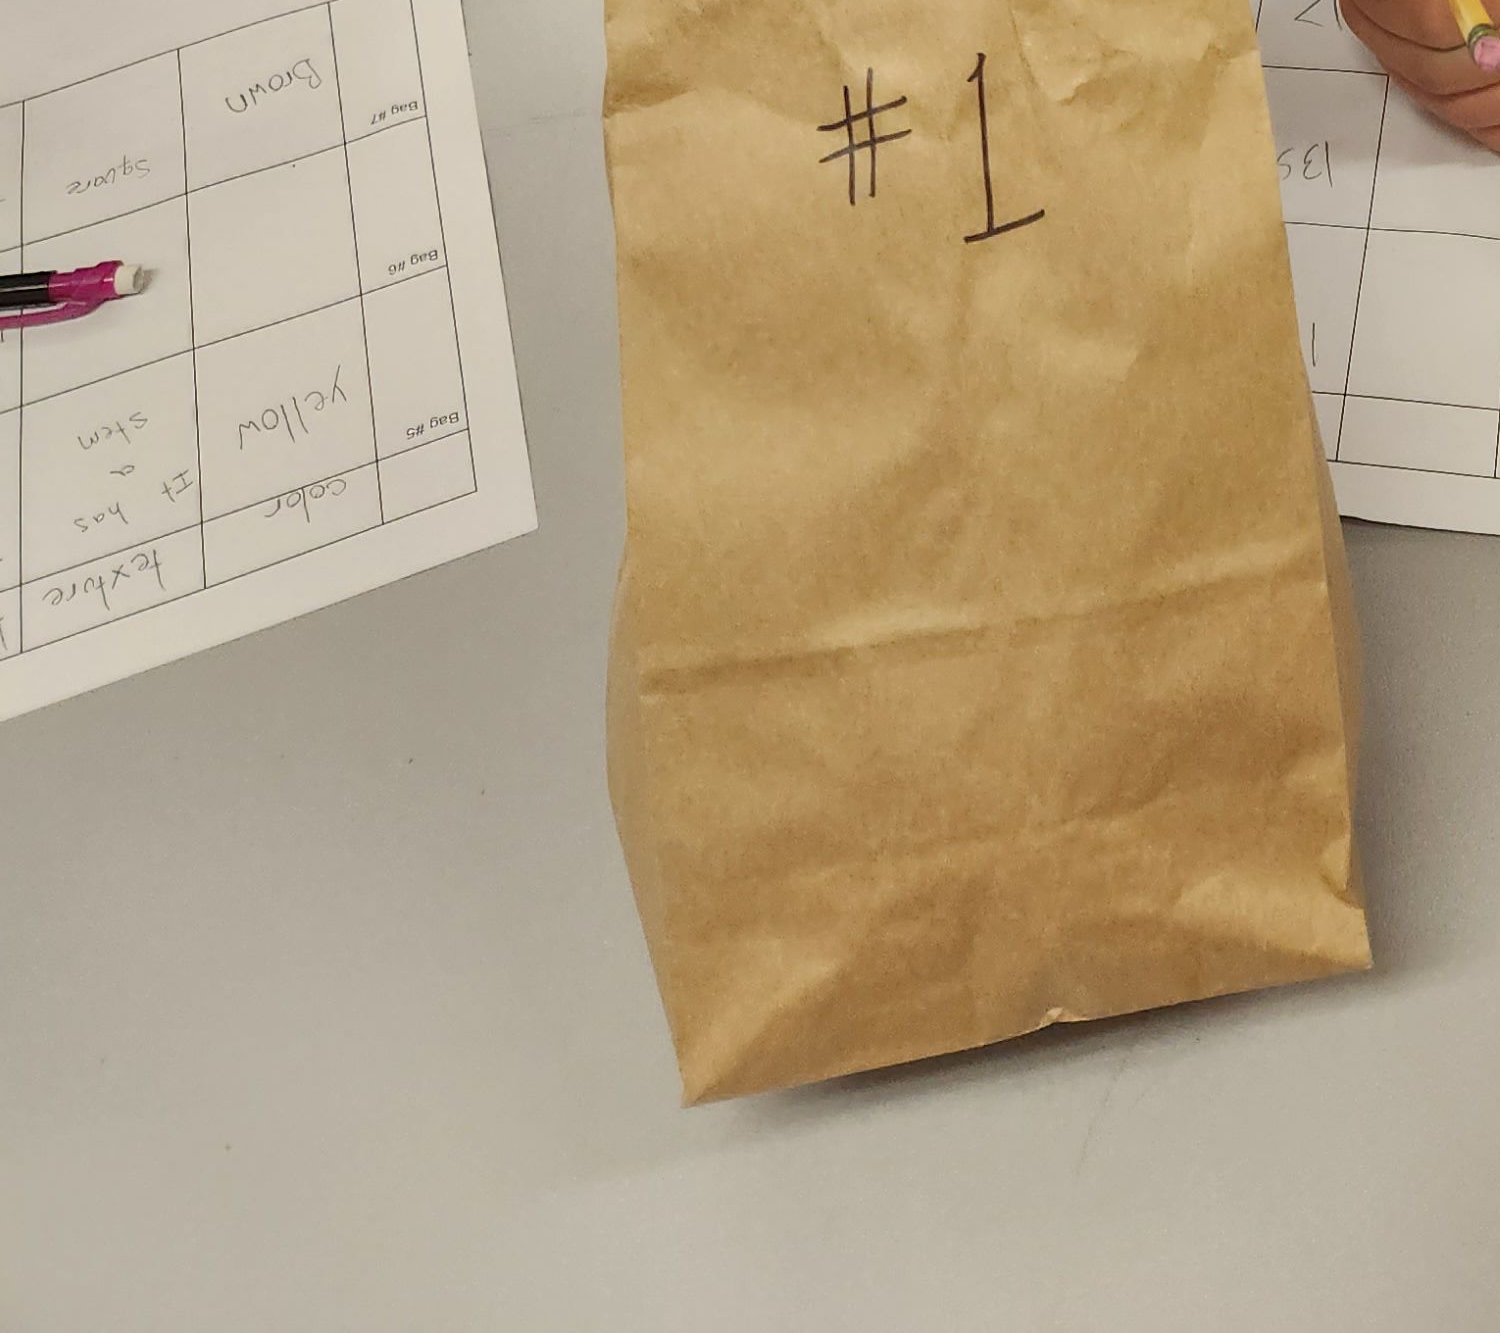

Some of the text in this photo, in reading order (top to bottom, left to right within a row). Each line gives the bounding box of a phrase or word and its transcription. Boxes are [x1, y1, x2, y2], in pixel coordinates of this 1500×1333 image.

[225, 57, 323, 115] Brown
[370, 100, 419, 126] Bag #7
[65, 154, 152, 196] square
[387, 249, 439, 276] Bag #6
[238, 364, 347, 451] yellow
[405, 411, 460, 441] Bag #5
[77, 411, 150, 451] stem
[109, 464, 136, 477] a
[73, 469, 194, 533] It has
[263, 478, 346, 524] color
[41, 548, 167, 612] texture
